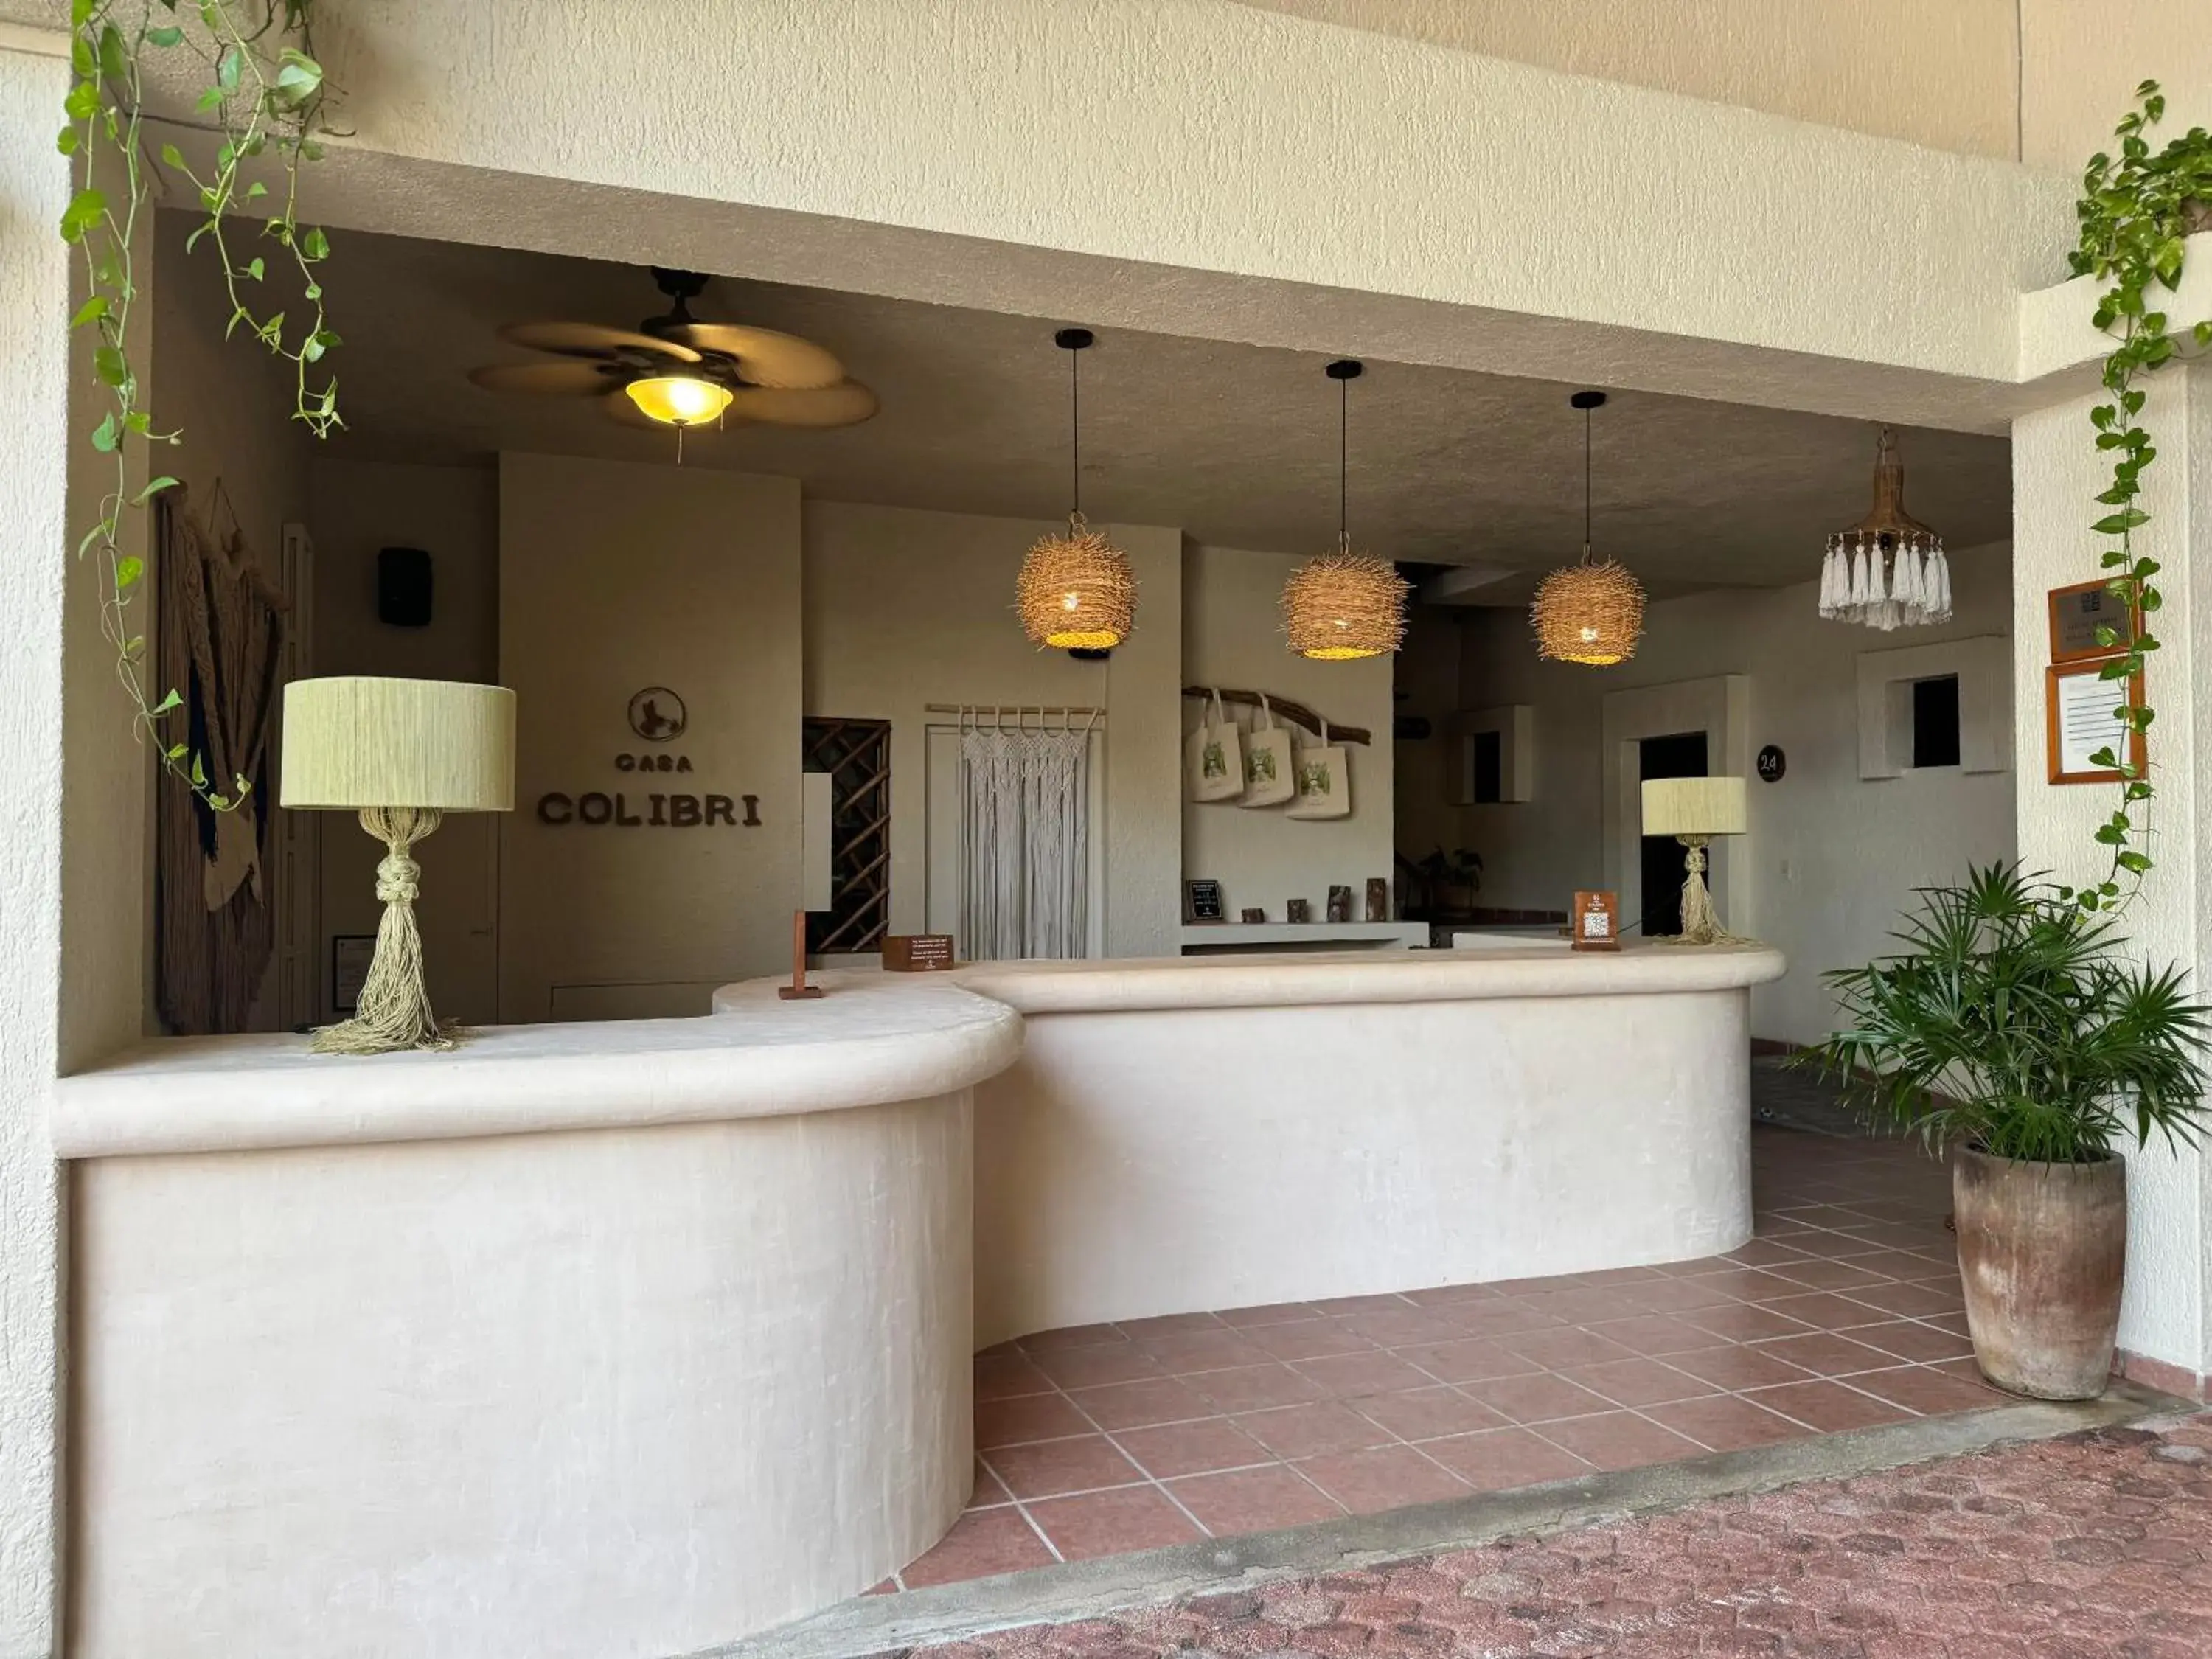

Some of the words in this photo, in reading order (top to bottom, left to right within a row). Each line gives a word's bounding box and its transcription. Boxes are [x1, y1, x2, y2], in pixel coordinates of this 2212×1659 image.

[615, 753, 694, 773] CASA
[1760, 754, 1776, 771] 24
[537, 791, 762, 827] COLIBRI
